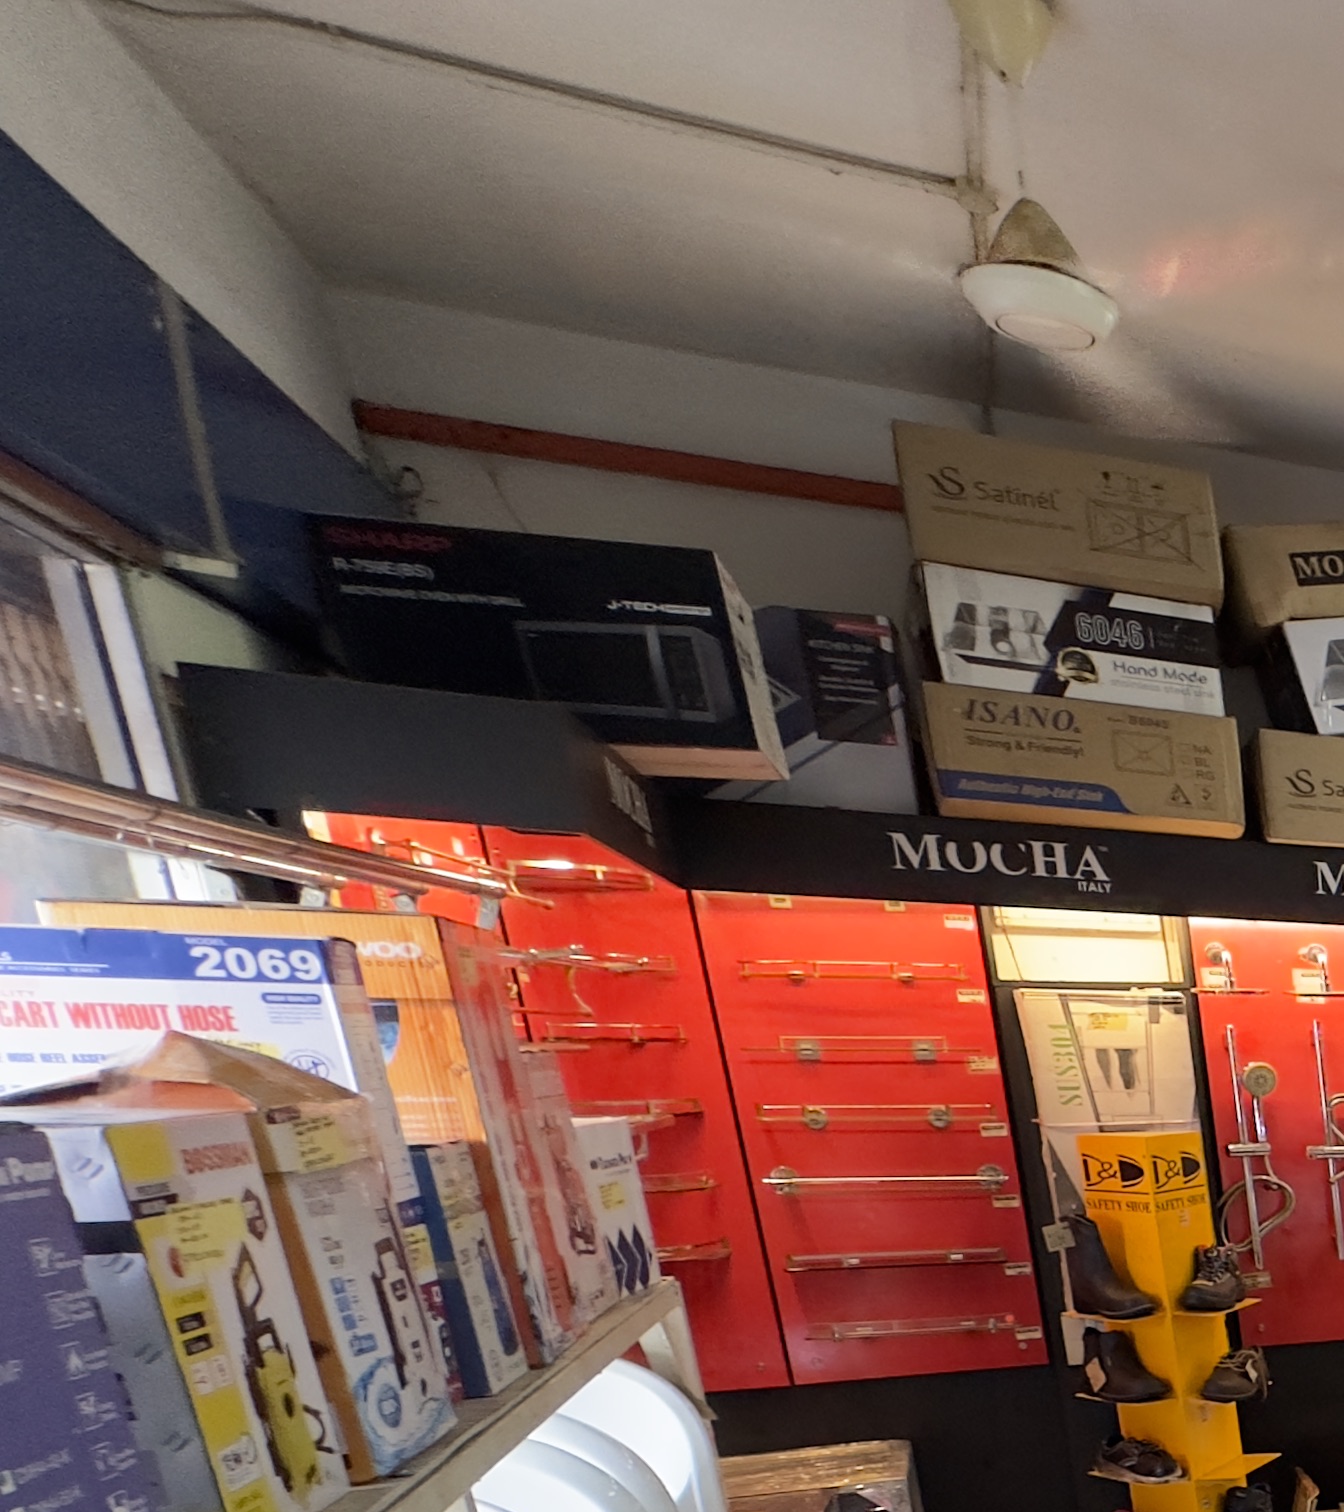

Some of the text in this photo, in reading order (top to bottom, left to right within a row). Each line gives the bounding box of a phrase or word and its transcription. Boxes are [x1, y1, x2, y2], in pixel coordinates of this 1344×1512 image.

[1075, 612, 1145, 650] 6046
[1112, 660, 1208, 685] Hand Made
[961, 698, 1075, 732] ISANO
[886, 831, 1112, 881] MOCHA
[1078, 881, 1112, 894] ITALY
[189, 947, 321, 981] 2069
[0, 1001, 61, 1029] CART
[65, 1003, 173, 1031] WITHOUT
[178, 1005, 239, 1032] HOSE
[1048, 1023, 1083, 1106] SUS304
[1081, 1153, 1145, 1188] D&D
[1151, 1151, 1201, 1189] D&D
[1086, 1199, 1152, 1213] SAFETY SHOE
[1155, 1198, 1186, 1212] SAFETY
